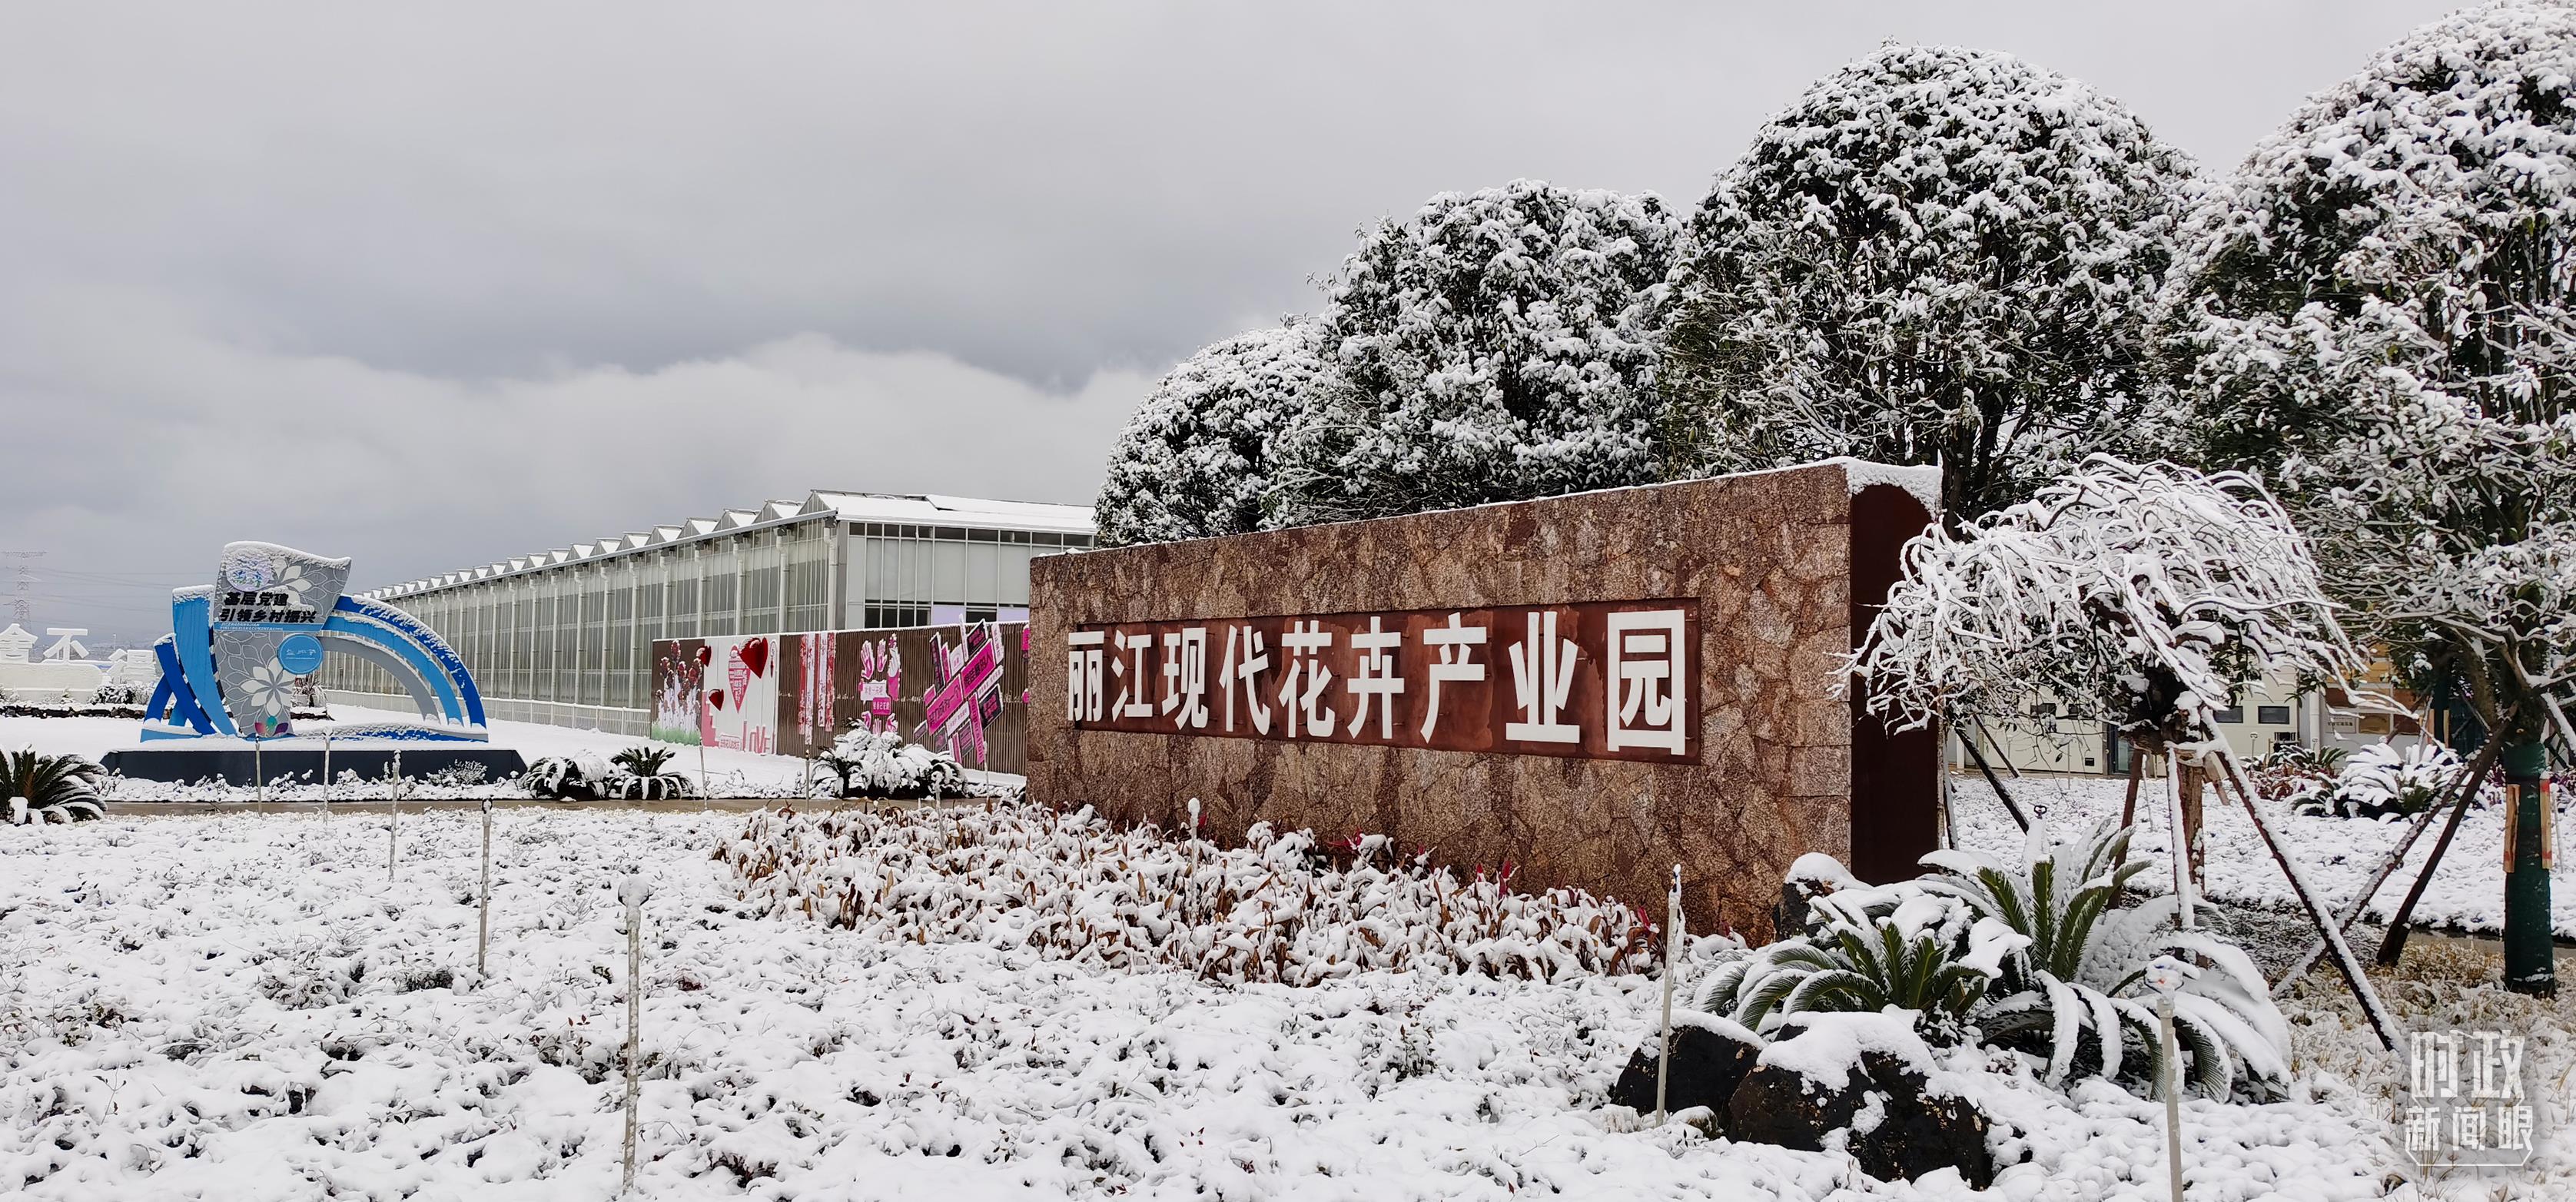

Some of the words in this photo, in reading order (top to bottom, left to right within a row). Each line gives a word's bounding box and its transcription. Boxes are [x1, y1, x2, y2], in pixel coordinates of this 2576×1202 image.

[224, 592, 289, 606] 基层党建
[219, 608, 317, 623] 引领乡村振兴
[1067, 609, 1687, 756] 丽江现代花卉产业园
